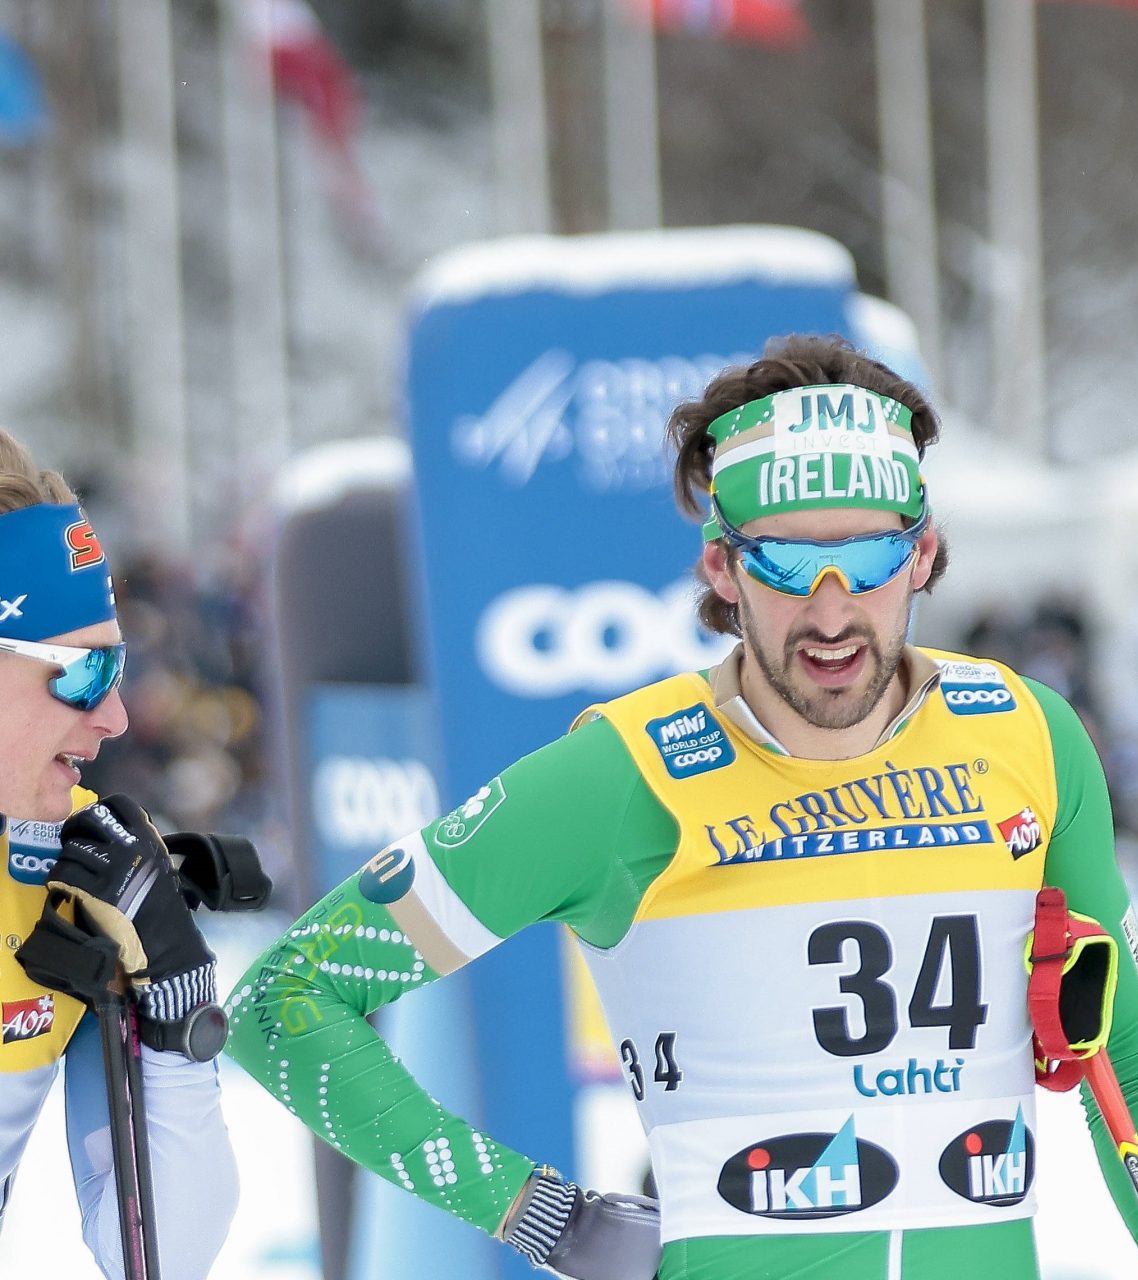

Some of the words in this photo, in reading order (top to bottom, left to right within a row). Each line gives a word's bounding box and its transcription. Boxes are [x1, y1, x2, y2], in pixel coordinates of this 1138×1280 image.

[788, 393, 876, 433] JMJ
[759, 453, 910, 506] IRELAND
[945, 688, 1011, 706] coop
[662, 739, 698, 754] WORLD
[700, 730, 721, 744] CUP
[674, 746, 723, 767] coop
[703, 814, 768, 865] LE
[725, 824, 981, 862] WITZERLAND
[1004, 821, 1041, 853] AOP
[10, 853, 58, 873] coo
[807, 913, 989, 1058] 34
[3, 1010, 54, 1036] AOP
[620, 1031, 684, 1101] 34
[852, 1057, 966, 1098] Lahti
